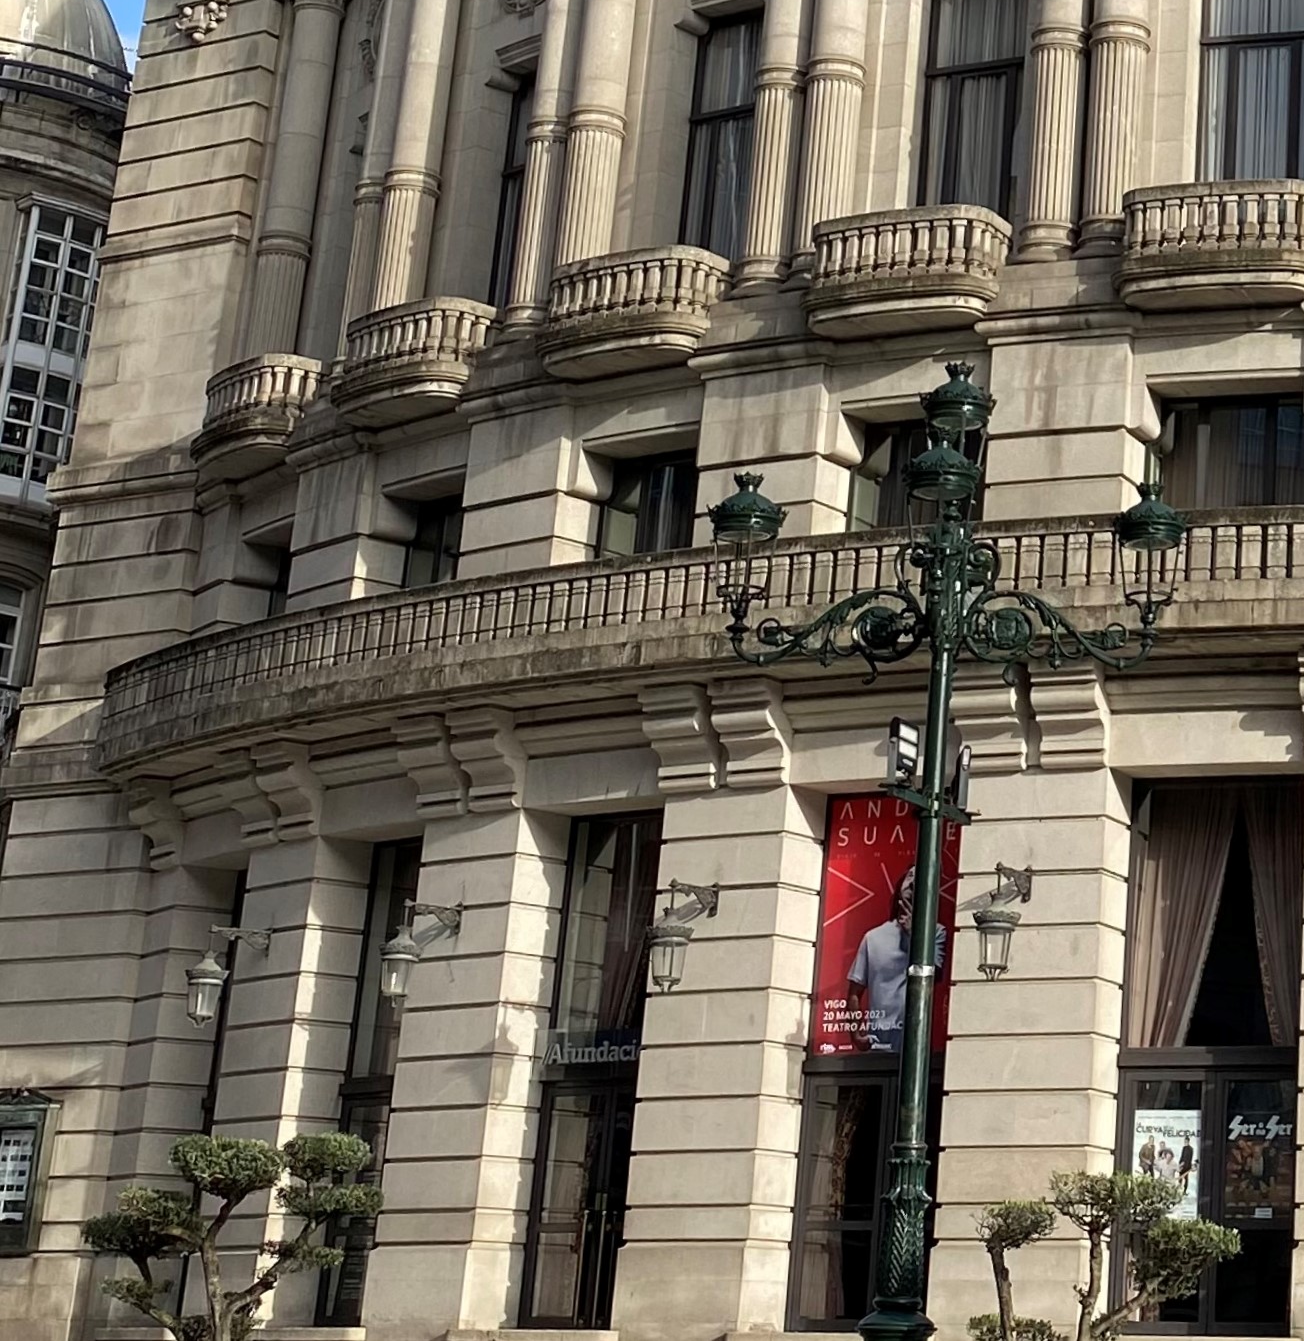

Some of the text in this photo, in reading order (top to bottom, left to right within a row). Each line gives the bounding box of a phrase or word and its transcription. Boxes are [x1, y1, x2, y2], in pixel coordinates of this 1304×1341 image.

[840, 800, 909, 819] AND
[824, 1000, 847, 1009] VIGO
[823, 1010, 886, 1021] 20 MAYO 2023
[823, 1021, 903, 1033] TEATRO AFUNDAC
[1136, 1124, 1163, 1134] CURVA
